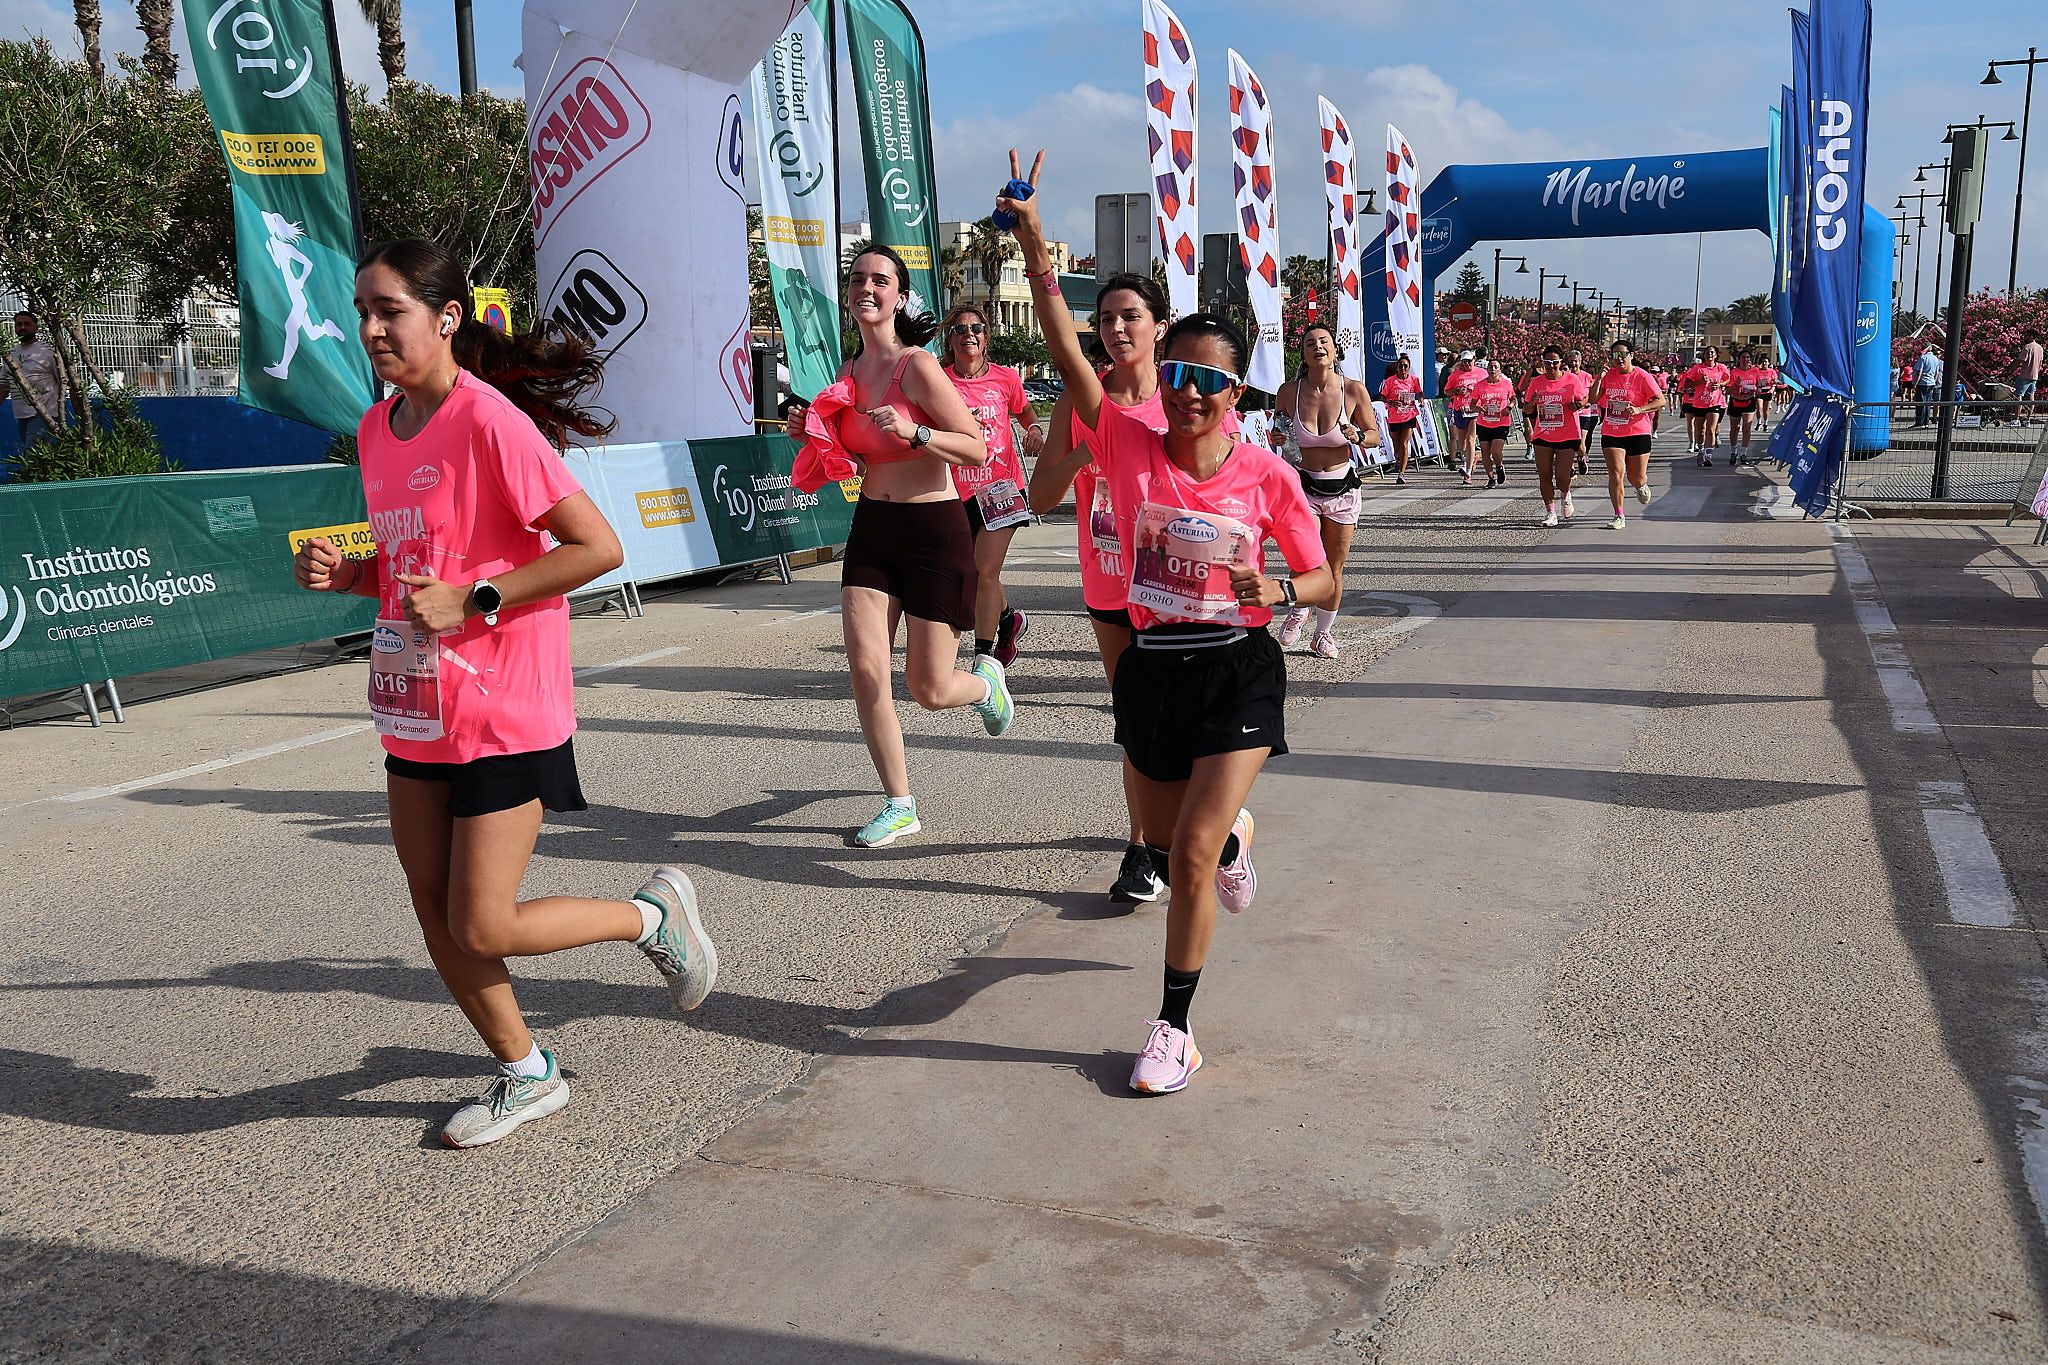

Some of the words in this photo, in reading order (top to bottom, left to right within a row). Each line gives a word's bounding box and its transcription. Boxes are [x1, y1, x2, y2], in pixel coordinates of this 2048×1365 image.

[958, 466, 993, 483] MUJER
[640, 497, 658, 510] 900
[658, 495, 672, 508] 131
[671, 493, 688, 506] 002
[996, 498, 1015, 510] 016
[644, 508, 691, 523] www.ioa.es
[1171, 523, 1215, 539] ASTURIANA
[1101, 541, 1121, 551] OYSH
[22, 546, 151, 582] Institutos
[1167, 556, 1209, 580] 016
[1142, 578, 1165, 590] CARRERA
[1166, 584, 1174, 592] DE
[1182, 589, 1199, 598] MUJER
[1176, 579, 1196, 590] 2156
[35, 570, 217, 617] Odontológicos
[1140, 590, 1174, 607] OYSHO
[1193, 605, 1227, 615] Santander
[47, 622, 98, 642] Clínicas
[98, 613, 154, 635] dentales
[374, 672, 408, 695] 016
[399, 723, 431, 734] Santander
